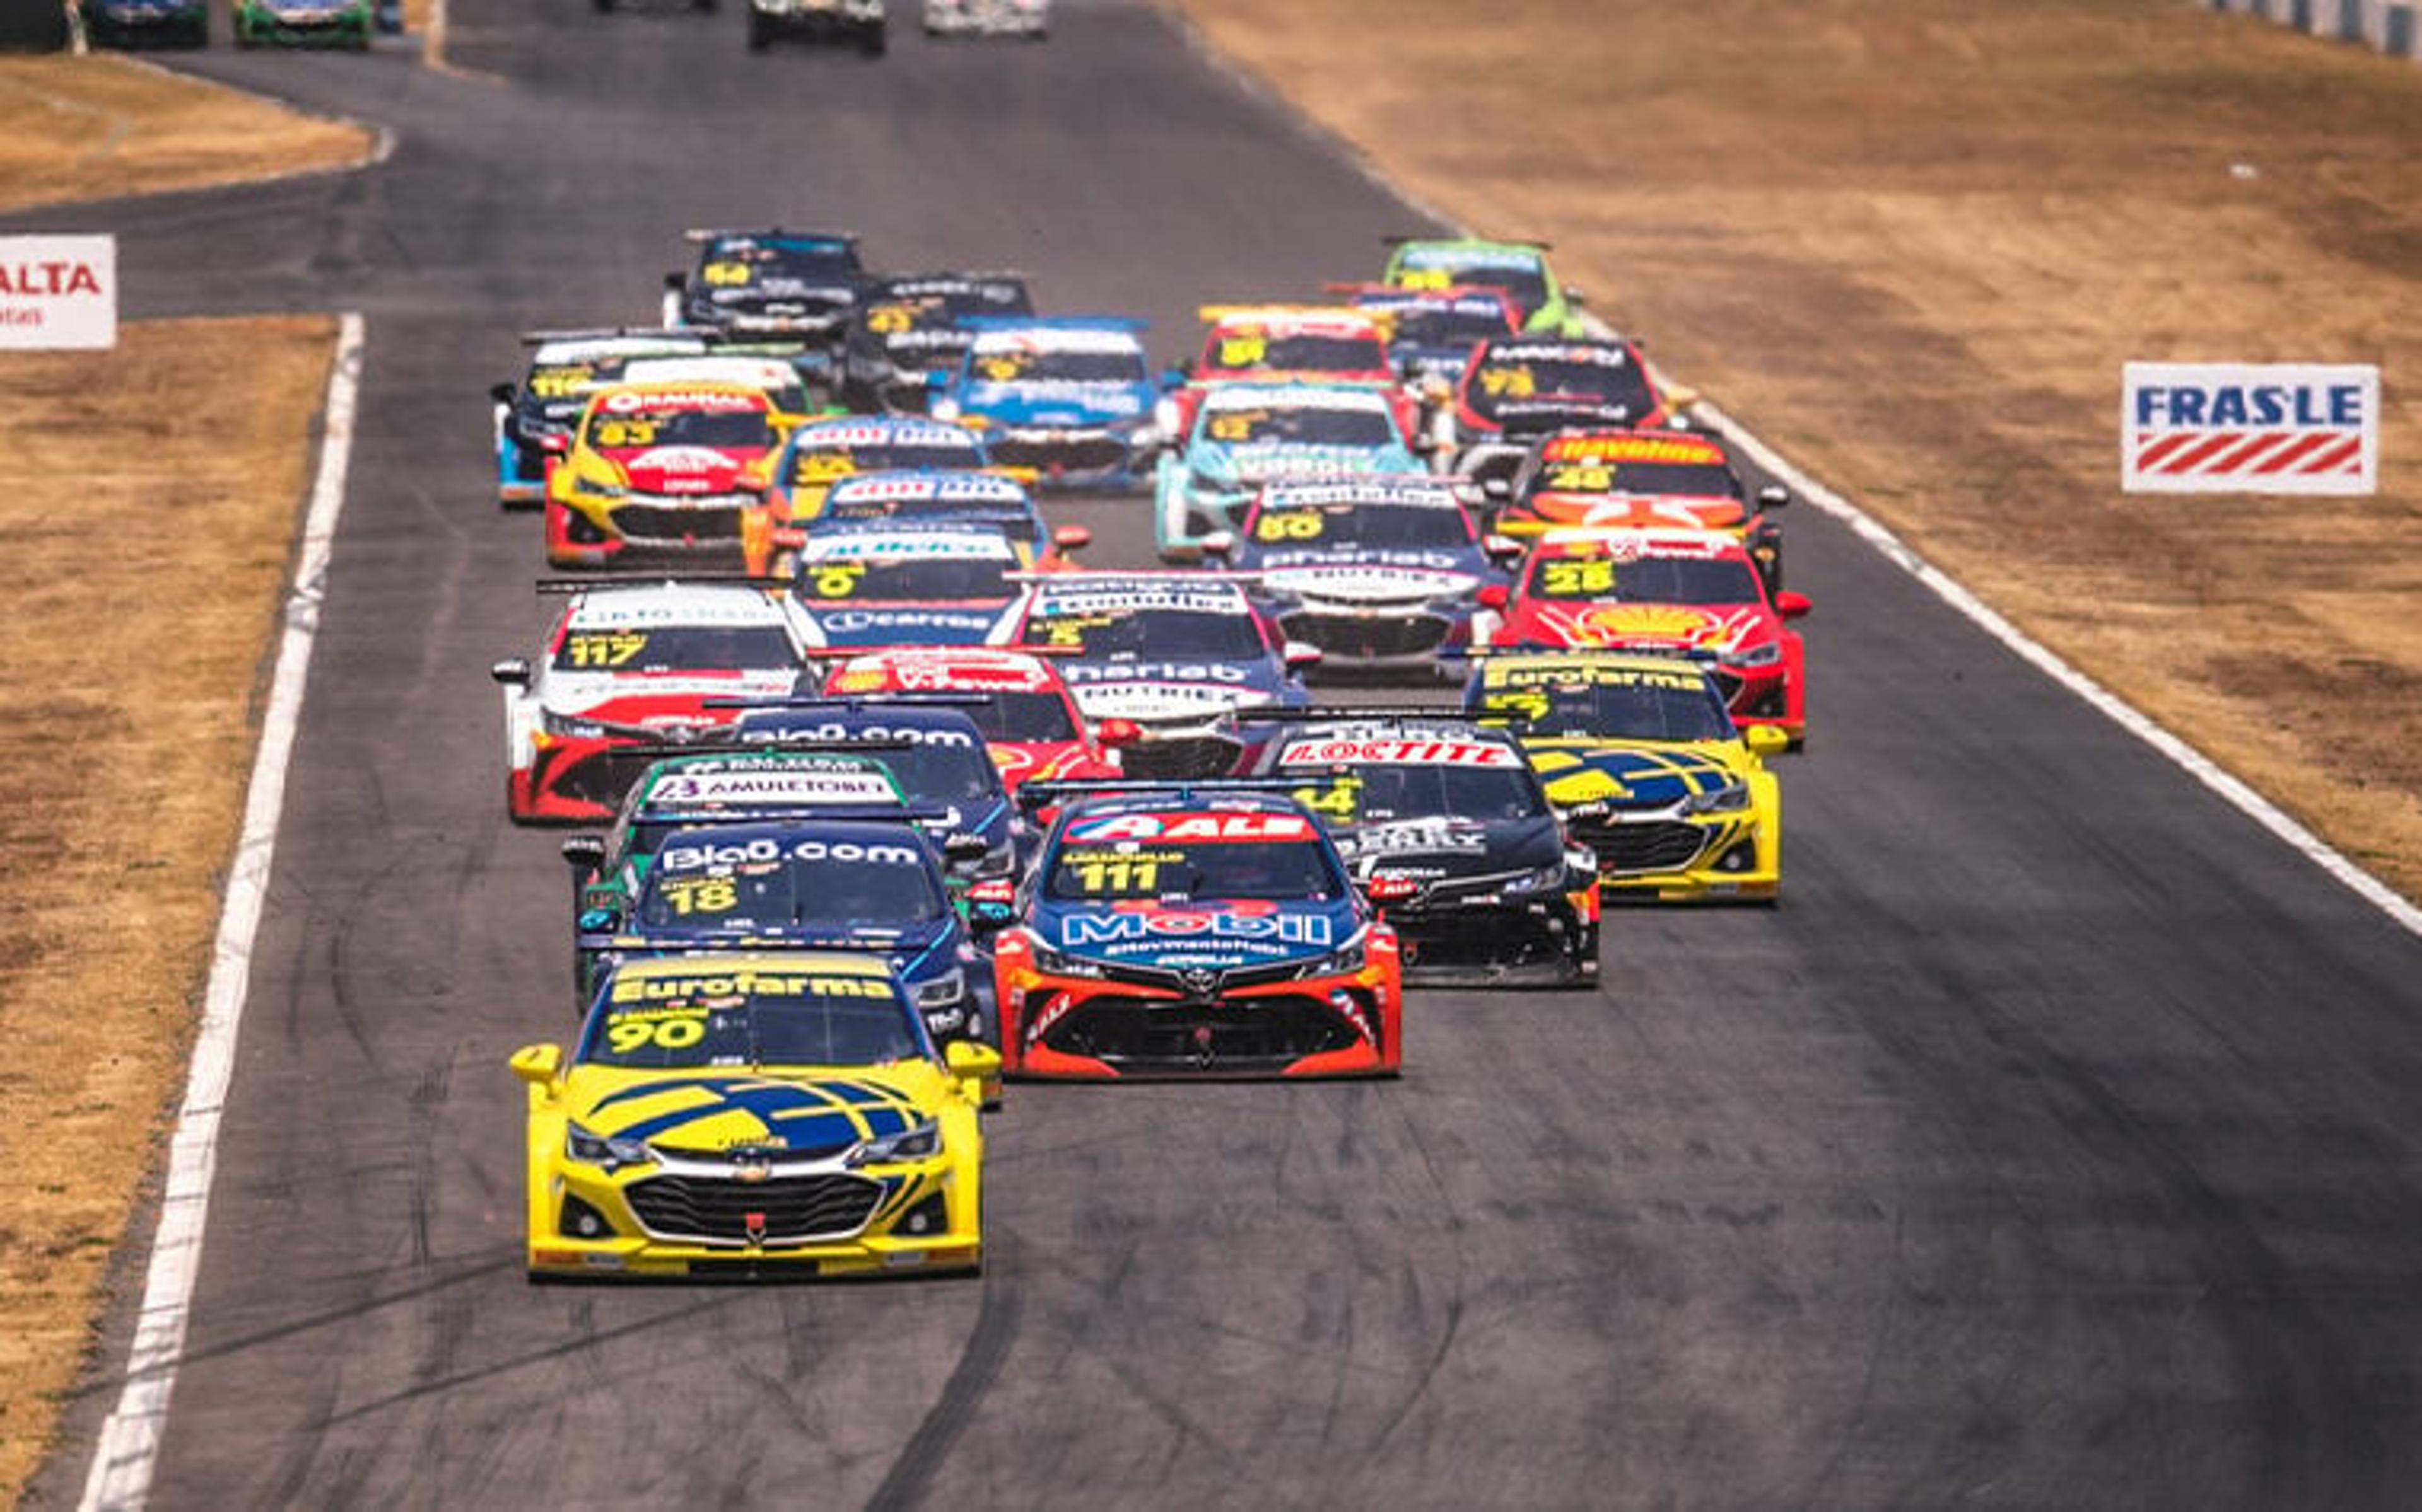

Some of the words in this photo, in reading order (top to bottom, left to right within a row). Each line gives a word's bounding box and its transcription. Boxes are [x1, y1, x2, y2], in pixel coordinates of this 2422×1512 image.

[1485, 665, 1706, 691] Eurofarma
[1284, 740, 1509, 764] LOCTITE
[1080, 864, 1157, 892] 111
[666, 884, 738, 914] 18
[1062, 912, 1333, 946] Mobil
[611, 973, 894, 1003] Eurofarma
[608, 1019, 706, 1053] 90
